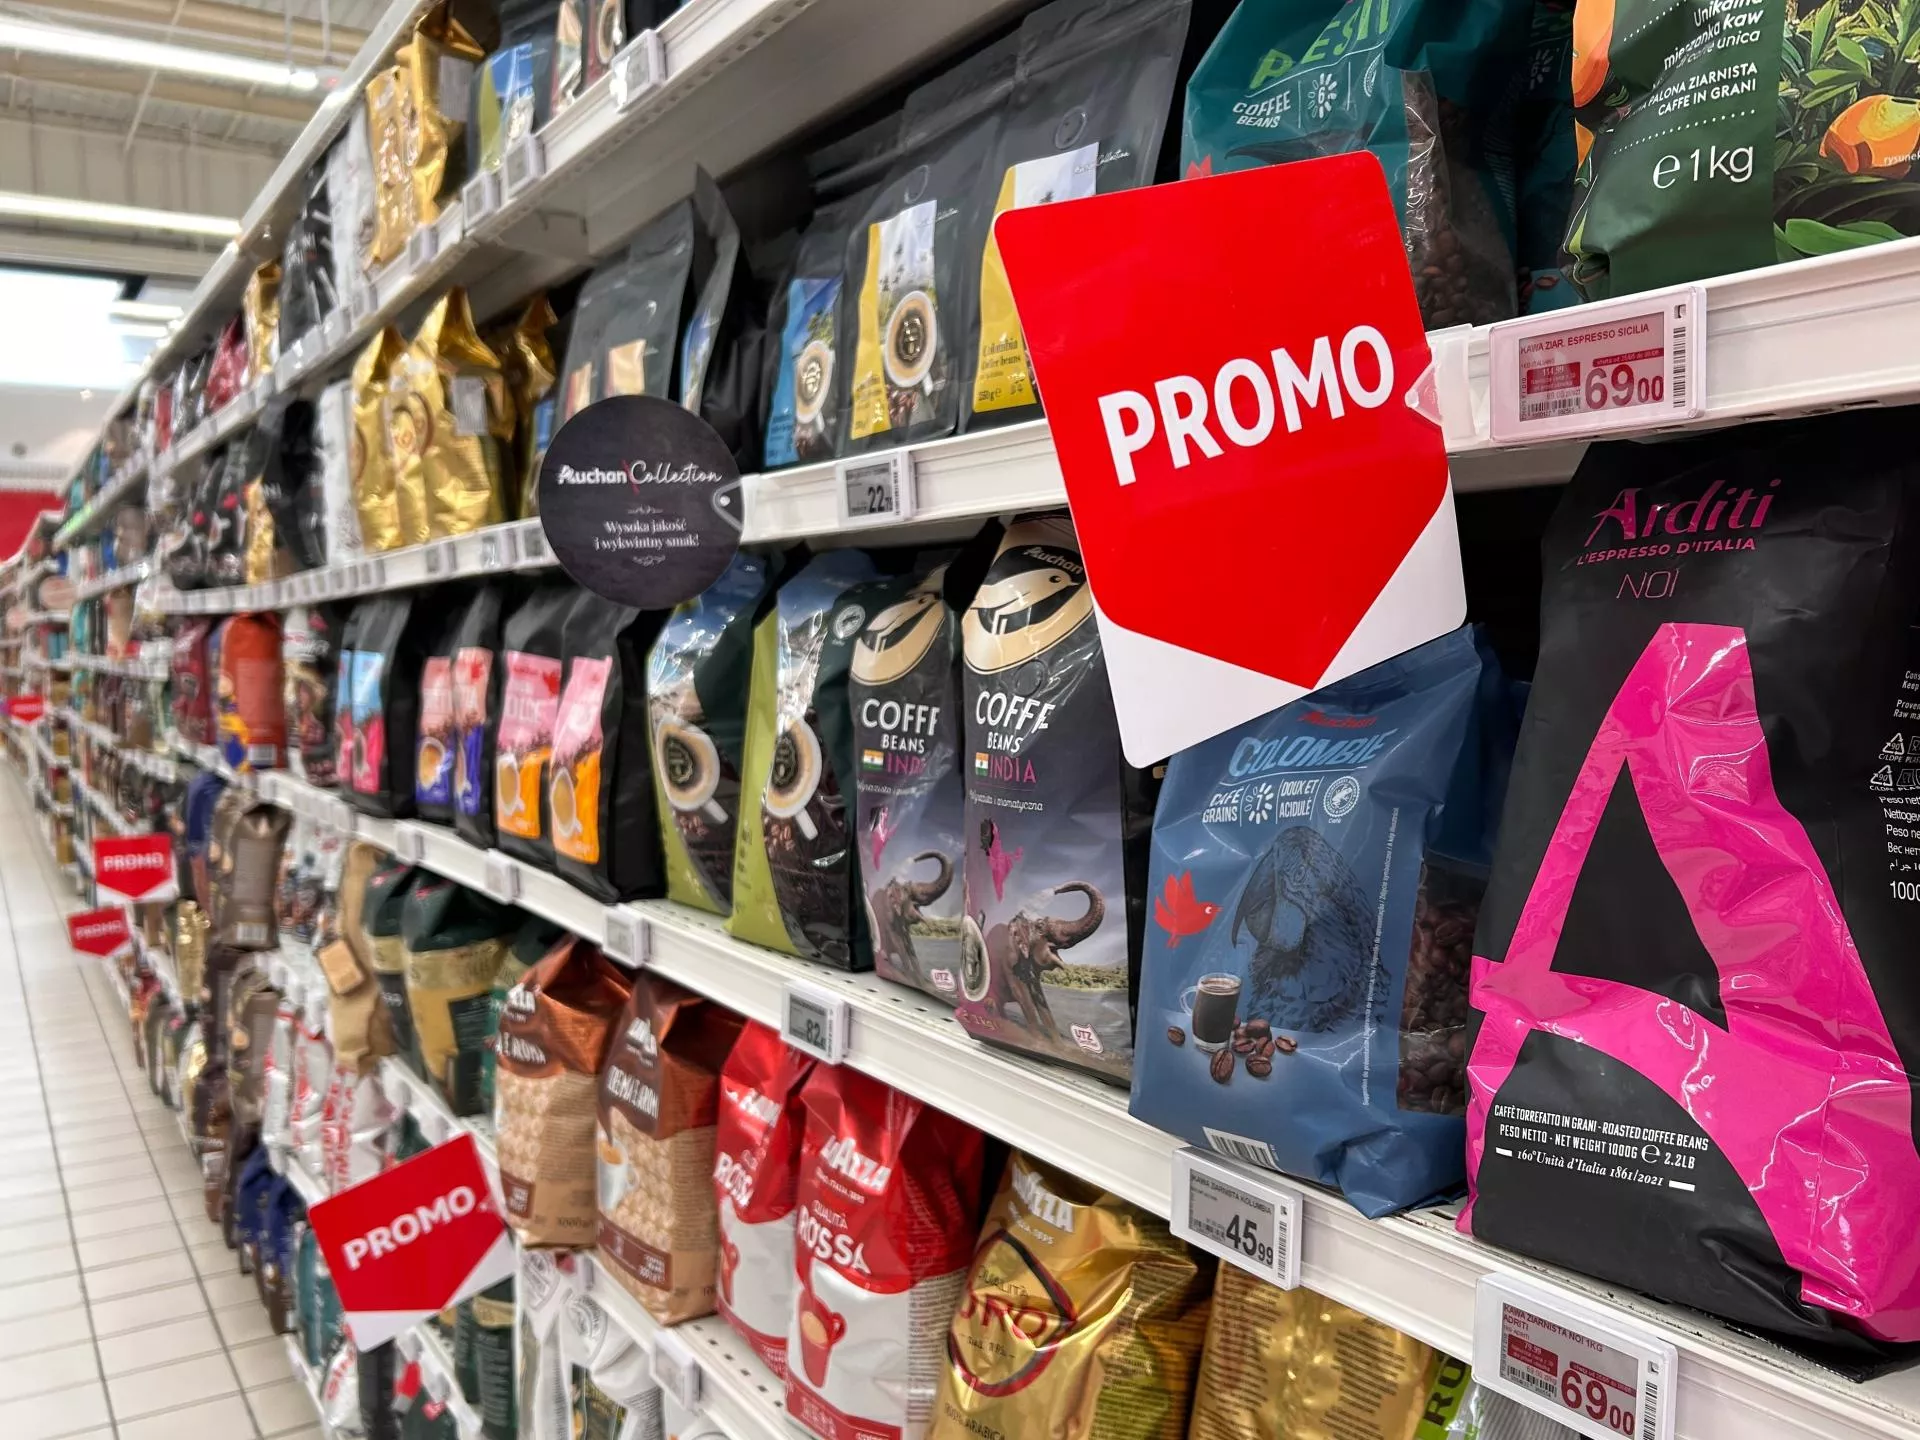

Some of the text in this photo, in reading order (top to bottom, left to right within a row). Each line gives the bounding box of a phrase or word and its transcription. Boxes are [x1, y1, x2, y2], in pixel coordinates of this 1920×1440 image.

[1723, 10, 1764, 30] kaw
[1717, 31, 1760, 49] unica
[1688, 62, 1757, 90] ZIARNISTA
[1233, 91, 1291, 114] COFFEE
[1693, 90, 1707, 104] IN
[1711, 79, 1756, 99] GRANI
[1236, 115, 1281, 128] BEANS
[1521, 340, 1544, 355] KAWA
[1568, 329, 1616, 346] ESPRESSO
[1618, 323, 1650, 337] SICILIA
[1098, 325, 1394, 487] PROMO
[557, 459, 722, 486] Auchan Collection
[1584, 479, 1782, 547] Arditi
[604, 518, 687, 534] Wysoka jakość
[595, 534, 700, 551] i wykwintny smak!
[1576, 537, 1756, 567] L'ESPRESSO D'ITALIA
[1023, 546, 1083, 575] Auchan
[1616, 568, 1679, 599] NOI
[881, 733, 925, 754] BEANS
[987, 732, 1024, 753] BEANS
[1228, 728, 1399, 777] COLOMBIE
[989, 753, 1037, 783] INDIA
[1281, 778, 1319, 797] DOUX ET
[1202, 806, 1238, 823] GRAINS
[1279, 796, 1312, 818] ACIDULÉ
[1886, 824, 1909, 837] Peso
[103, 851, 165, 871] PROMO
[1075, 1028, 1093, 1041] UTZ
[1494, 1105, 1516, 1119] CAFFÈ
[1516, 1108, 1561, 1126] TORREFATTO
[1561, 1115, 1570, 1128] IN
[1571, 1117, 1597, 1133] GRANI
[1602, 1122, 1641, 1140] ROASTED
[1642, 1129, 1675, 1146] COFFEE
[1676, 1133, 1709, 1151] BEANS
[1499, 1123, 1520, 1139] PESO
[1522, 1127, 1547, 1143] NETTO
[1555, 1134, 1571, 1148] NET
[1572, 1136, 1606, 1154] WEIGHT
[1608, 1142, 1638, 1159] 1000G
[1664, 1152, 1696, 1170] 2.2LB
[1567, 1158, 1606, 1176] d'Italia
[1610, 1165, 1663, 1186] 1861/2021
[342, 1185, 476, 1271] PROMO
[1504, 1314, 1529, 1332] ADRITI
[1504, 1304, 1603, 1353] KAWA ZIARNISTA NOI 1KG
